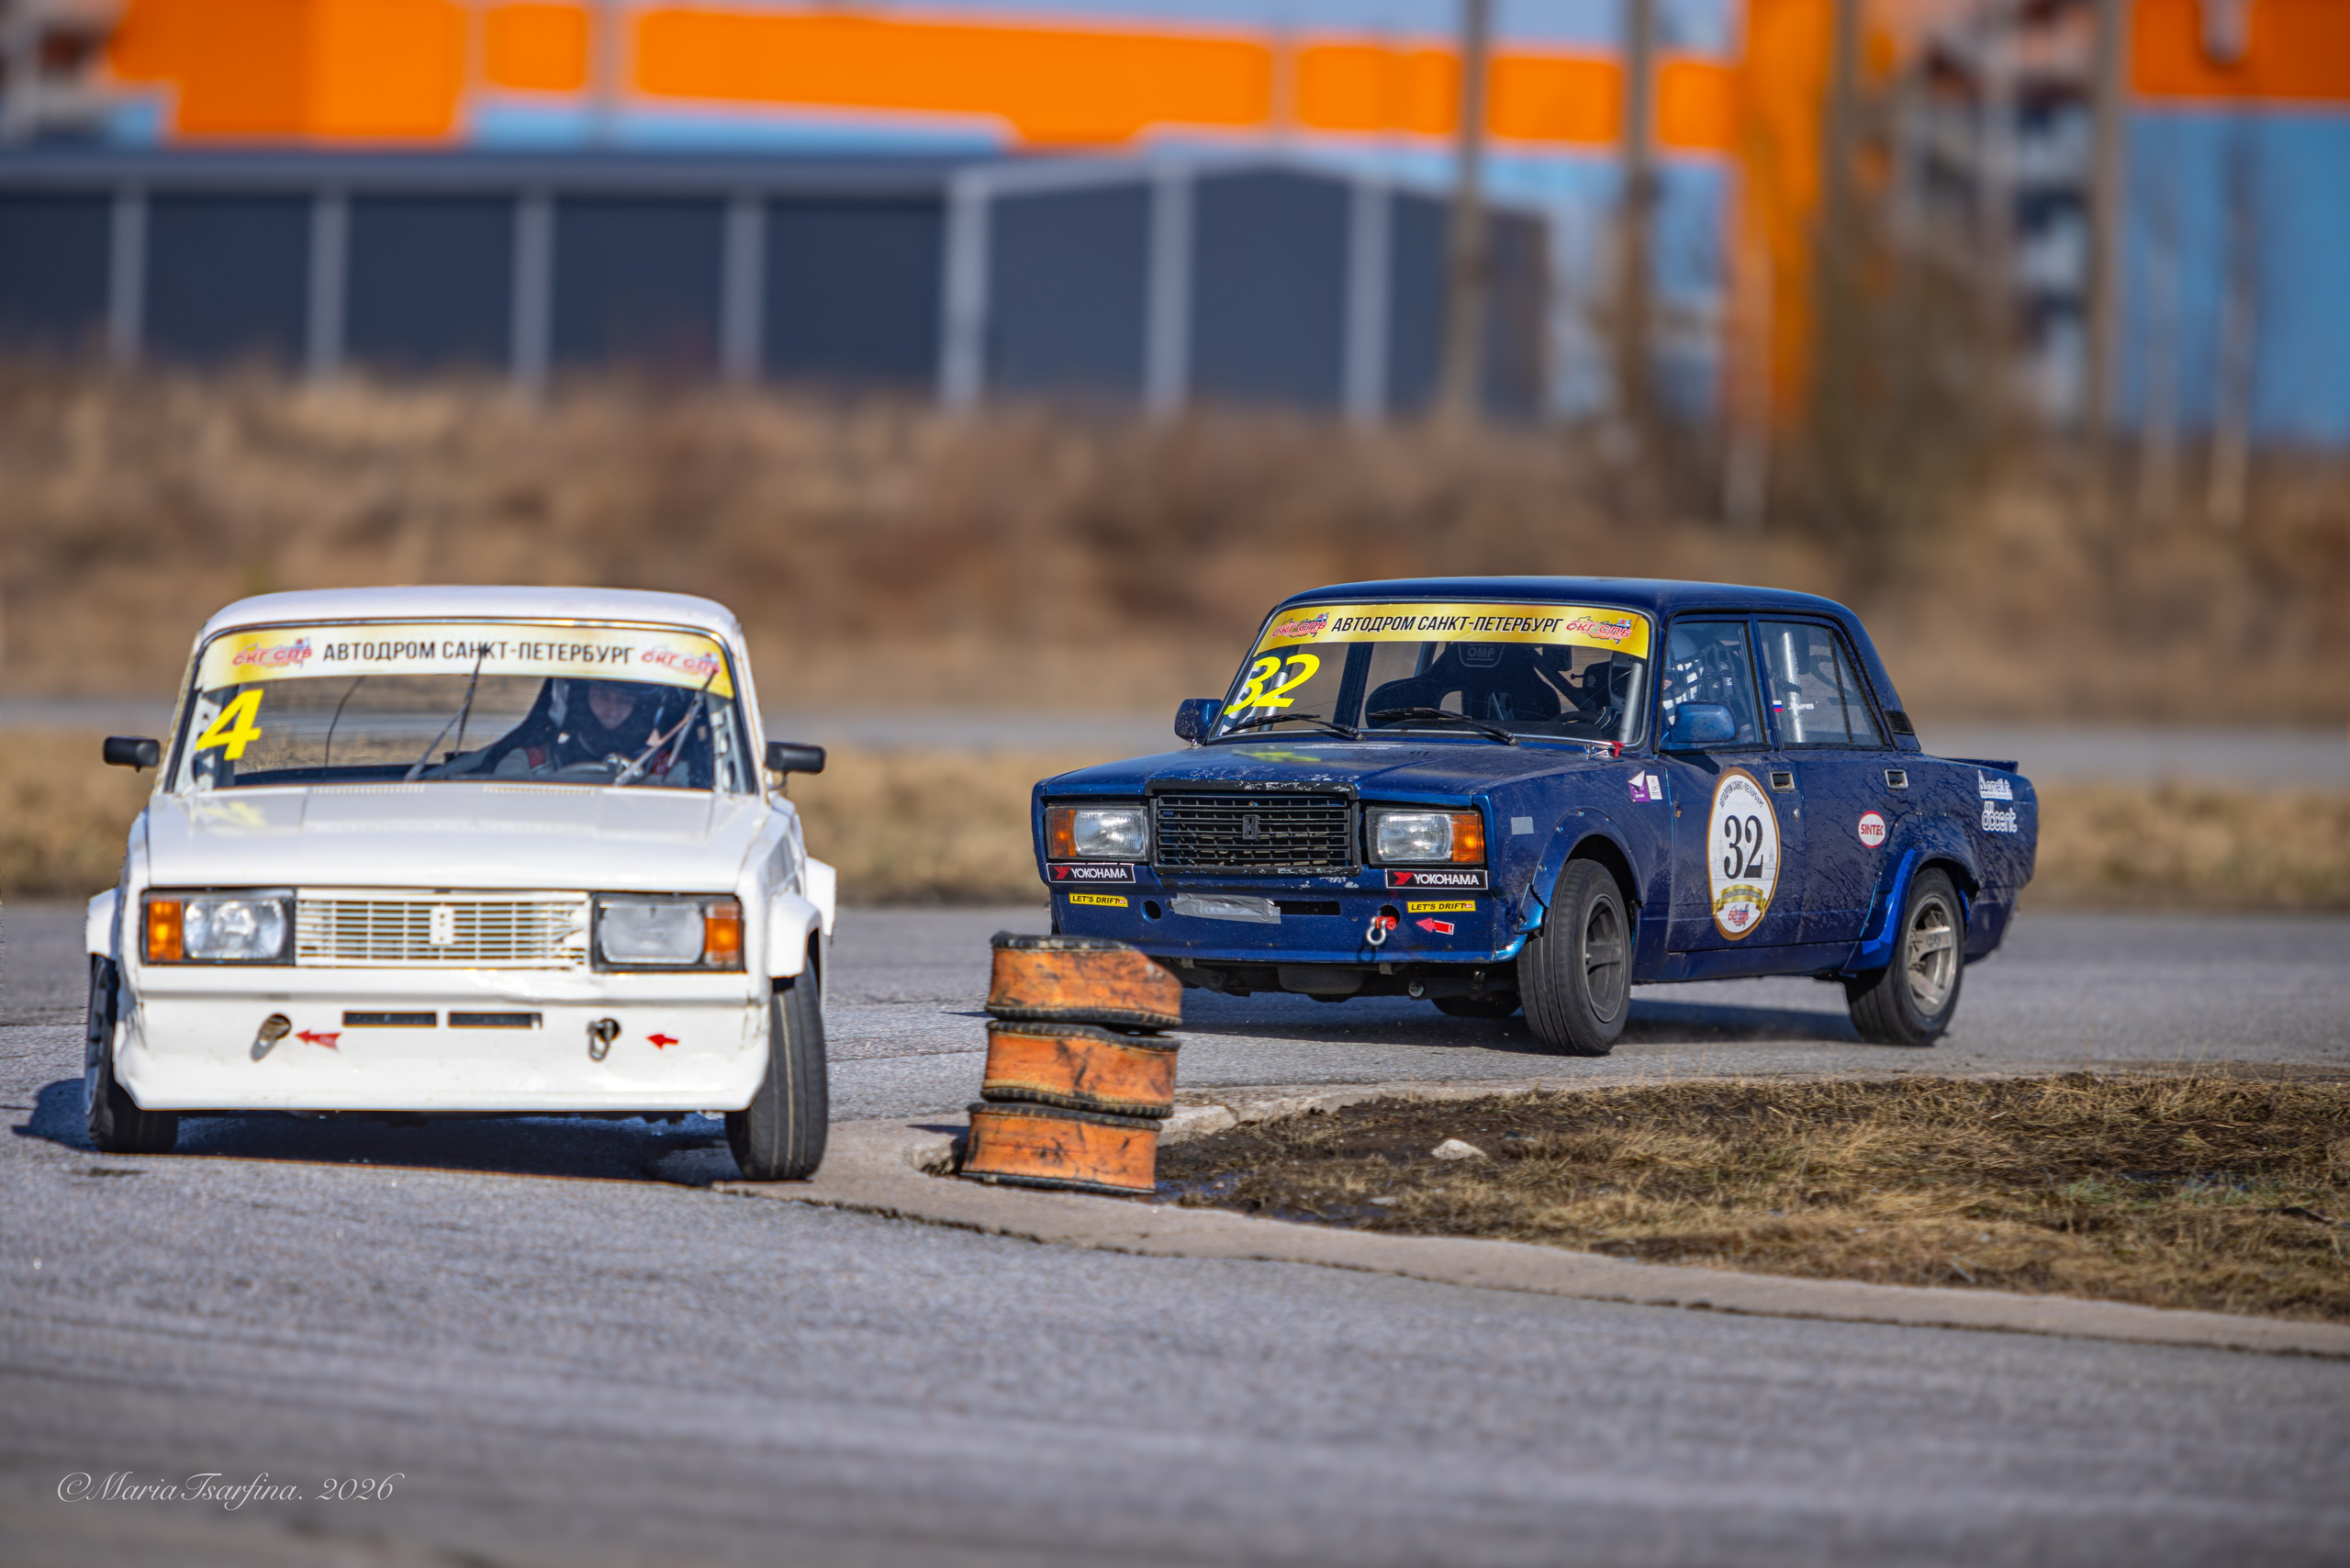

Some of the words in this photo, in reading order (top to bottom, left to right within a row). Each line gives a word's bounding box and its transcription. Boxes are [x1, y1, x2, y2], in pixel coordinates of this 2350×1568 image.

[1271, 623, 1296, 637] СКГ
[1298, 621, 1327, 633] СПБ
[1331, 616, 1416, 633] АВТОДРОМ
[1417, 616, 1563, 633] САНКТ-ПЕТЕРБУРГ
[1565, 622, 1596, 633] СКГ
[1597, 625, 1631, 638] СПБ
[323, 642, 435, 661] АВТОДРОМ
[442, 642, 634, 664] САНКТ-ПЕТЕРБУРГ
[1468, 646, 1495, 658] OMP
[1223, 654, 1320, 715] 32
[196, 689, 264, 761] 4
[1861, 824, 1884, 835] SINTEC
[1724, 815, 1763, 879] 32
[1071, 868, 1127, 879] YOKOHAMA
[1414, 873, 1480, 885] YOKOHAMA
[1072, 895, 1094, 903] LET'S
[1411, 902, 1436, 911] LET'S
